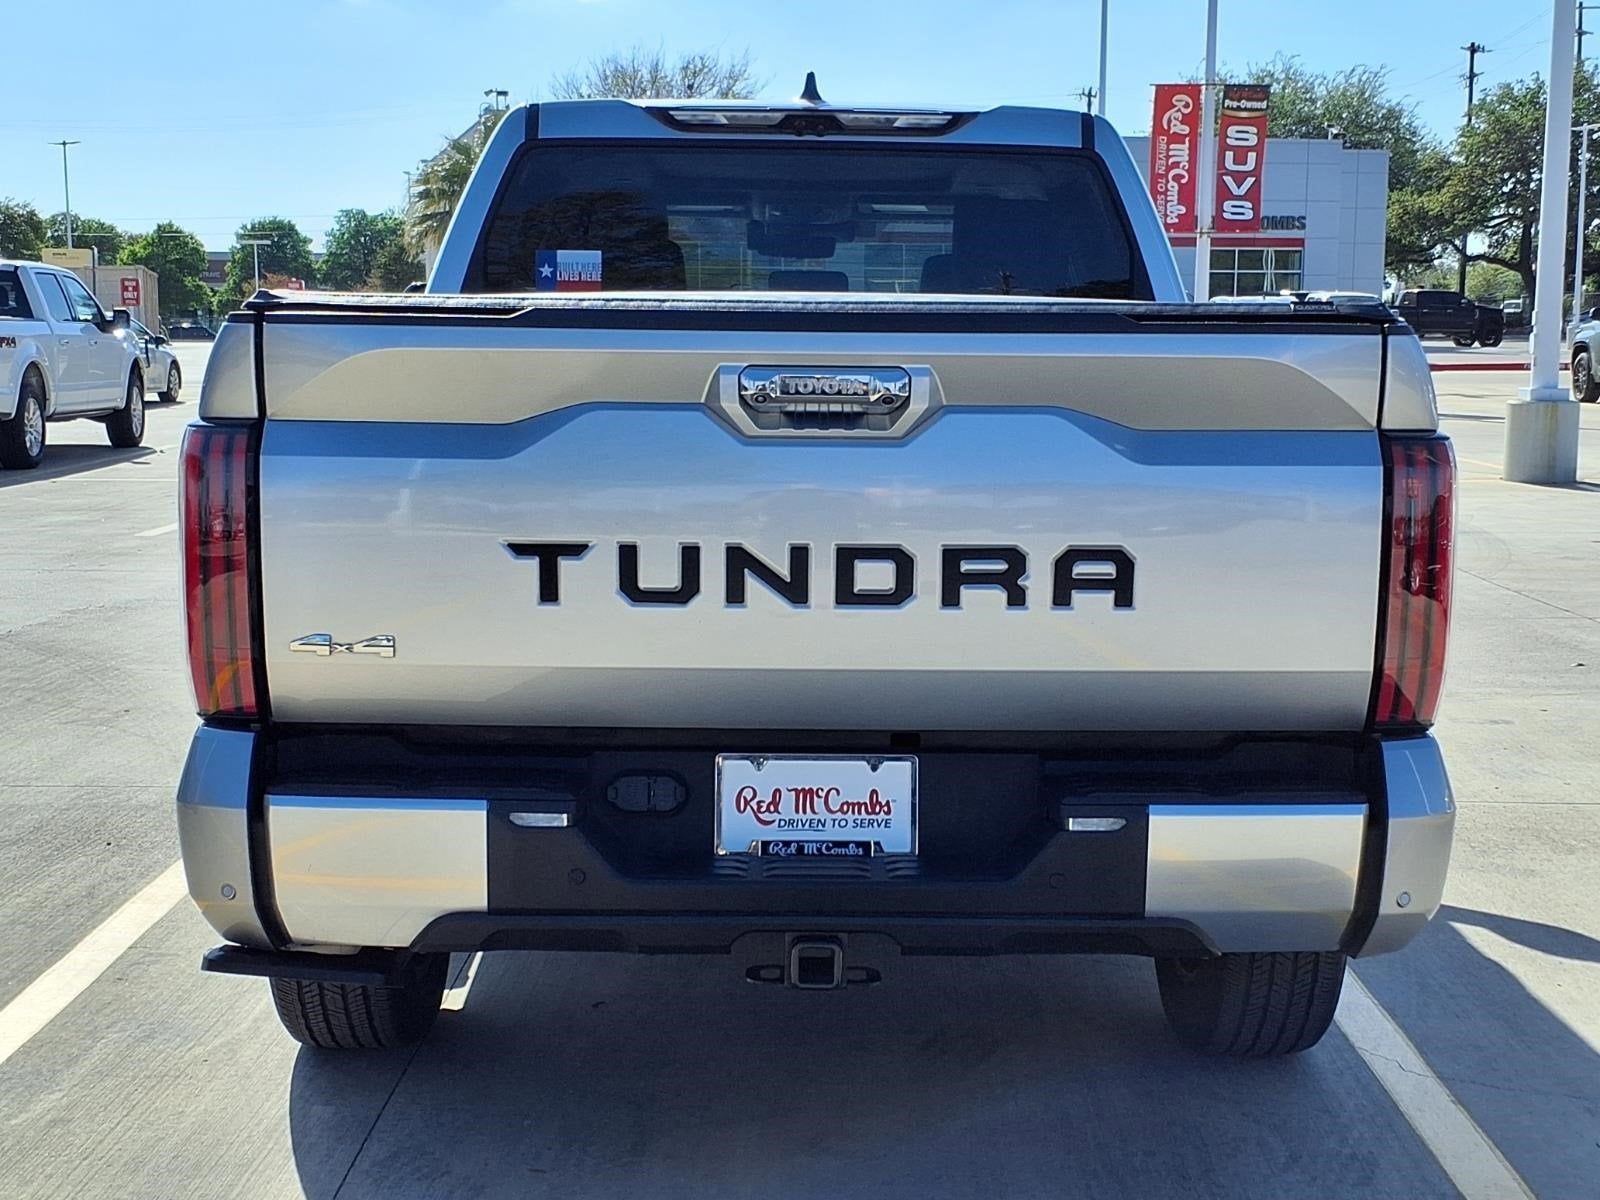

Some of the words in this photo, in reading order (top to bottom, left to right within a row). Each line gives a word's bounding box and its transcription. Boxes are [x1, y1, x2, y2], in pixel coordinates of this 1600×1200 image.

[1224, 99, 1267, 109] Pre-Owned
[1162, 94, 1193, 134] Red
[1158, 135, 1167, 174] DRIVEN
[1166, 136, 1189, 224] McCombs
[1222, 124, 1258, 221] SUVS
[1157, 177, 1166, 192] TO
[1261, 215, 1306, 231] OMBS
[581, 262, 602, 272] HERE
[557, 272, 579, 281] LIVES
[581, 272, 602, 281] HERE
[785, 377, 864, 395] TOYOTA
[500, 540, 1137, 609] TUNDRA
[289, 633, 395, 658] 4x4
[735, 785, 782, 826] Red
[786, 786, 891, 816] McCombs
[777, 818, 826, 829] DRIVEN
[830, 818, 849, 829] TO
[852, 818, 892, 829] SERVE
[769, 841, 797, 857] Red
[799, 841, 863, 856] McCombs
